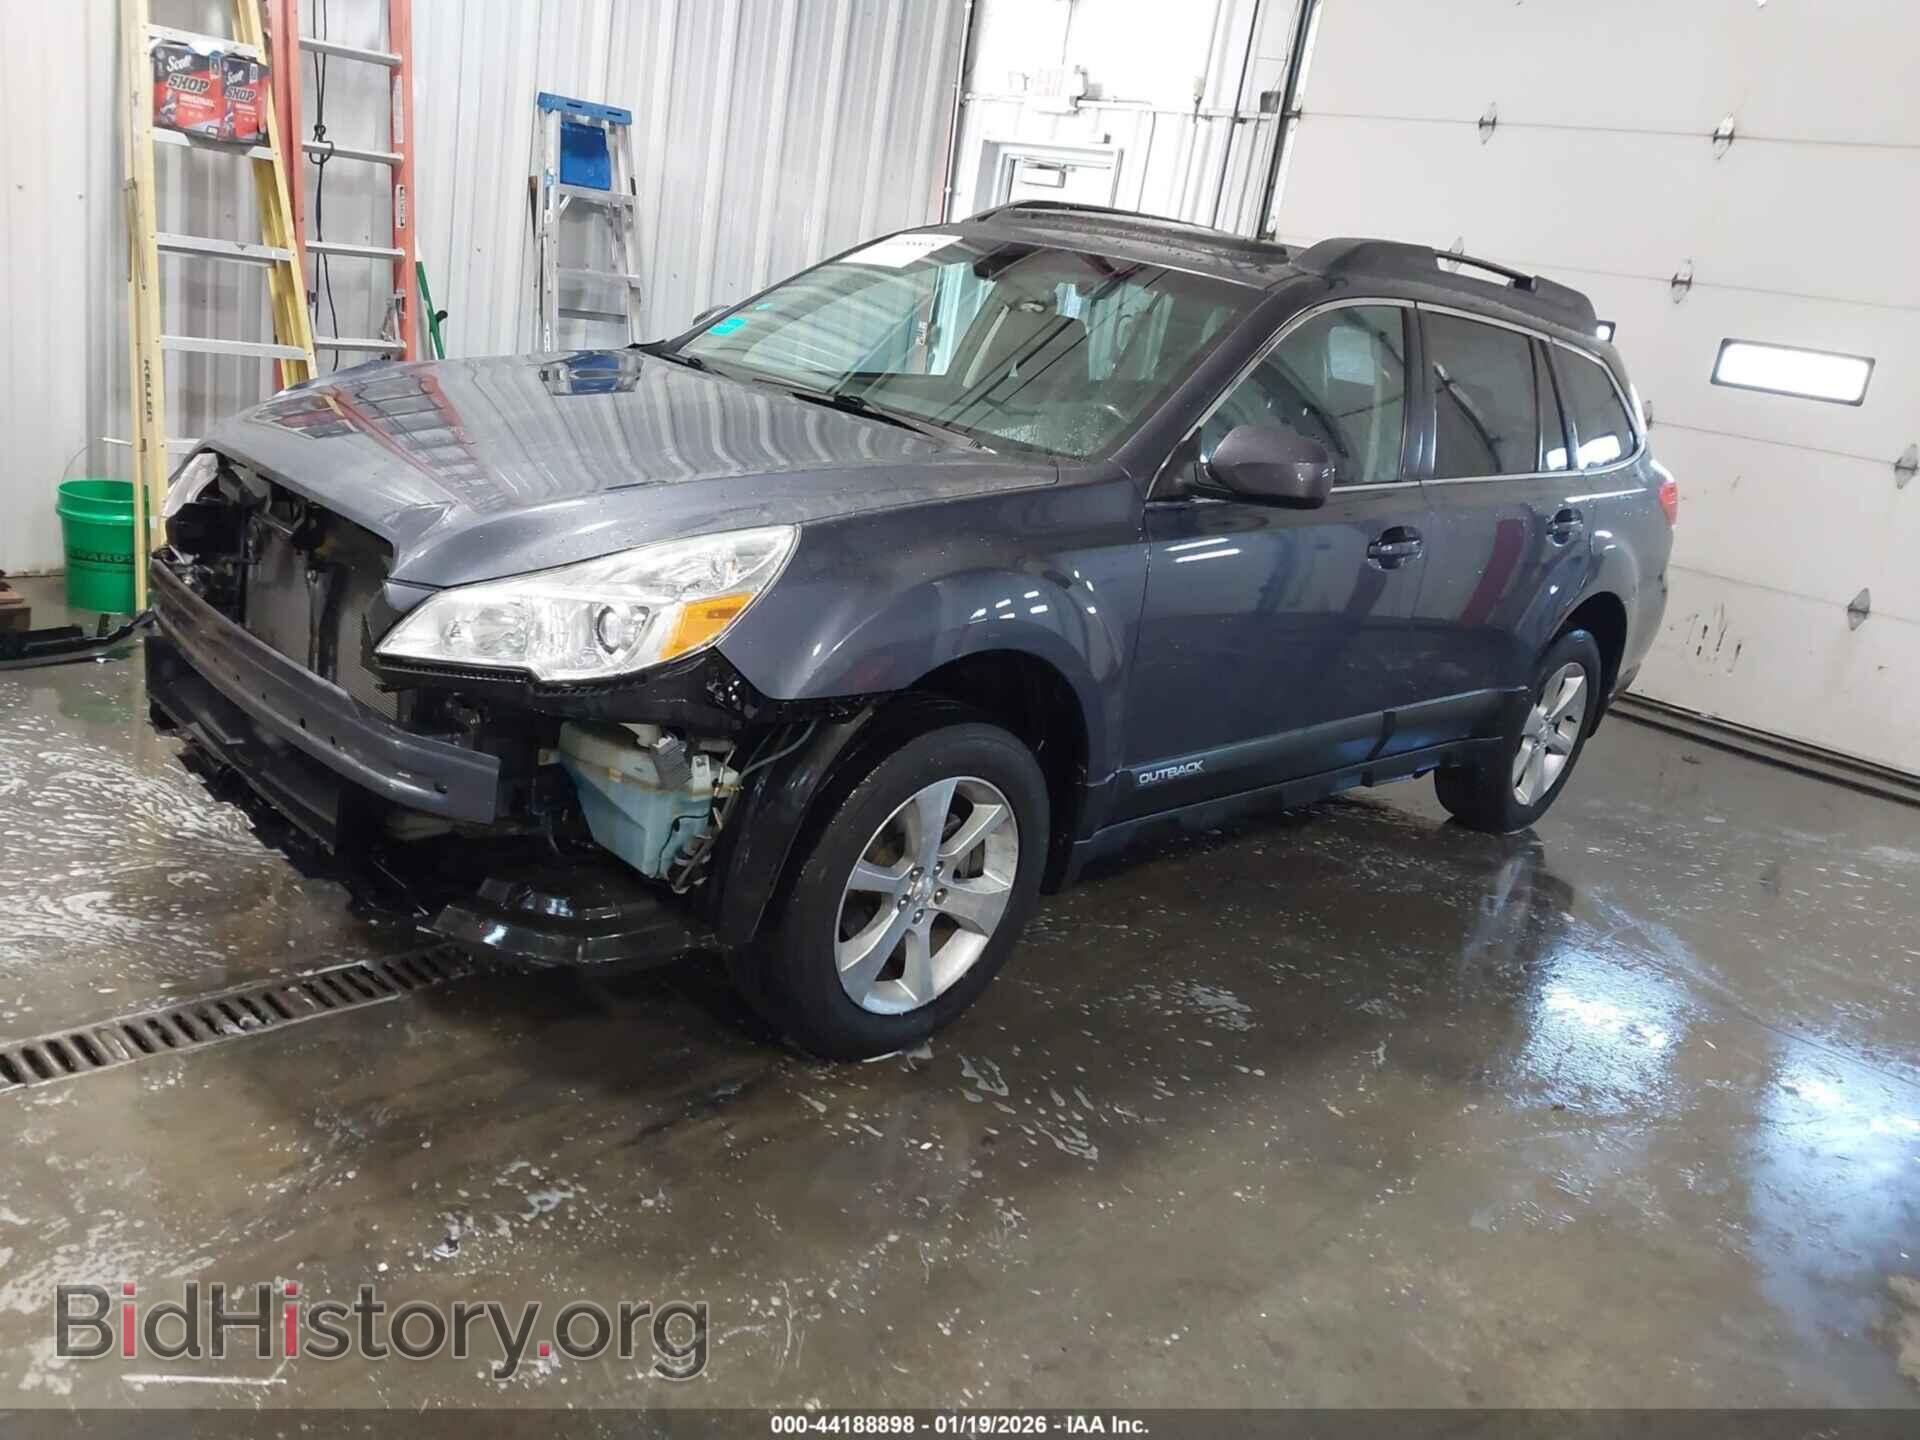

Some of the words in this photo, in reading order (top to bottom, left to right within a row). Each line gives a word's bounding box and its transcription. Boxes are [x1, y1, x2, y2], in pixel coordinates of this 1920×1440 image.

[168, 74, 210, 94] SHOP
[225, 87, 256, 102] SHOP
[1138, 760, 1205, 784] OUTBACK
